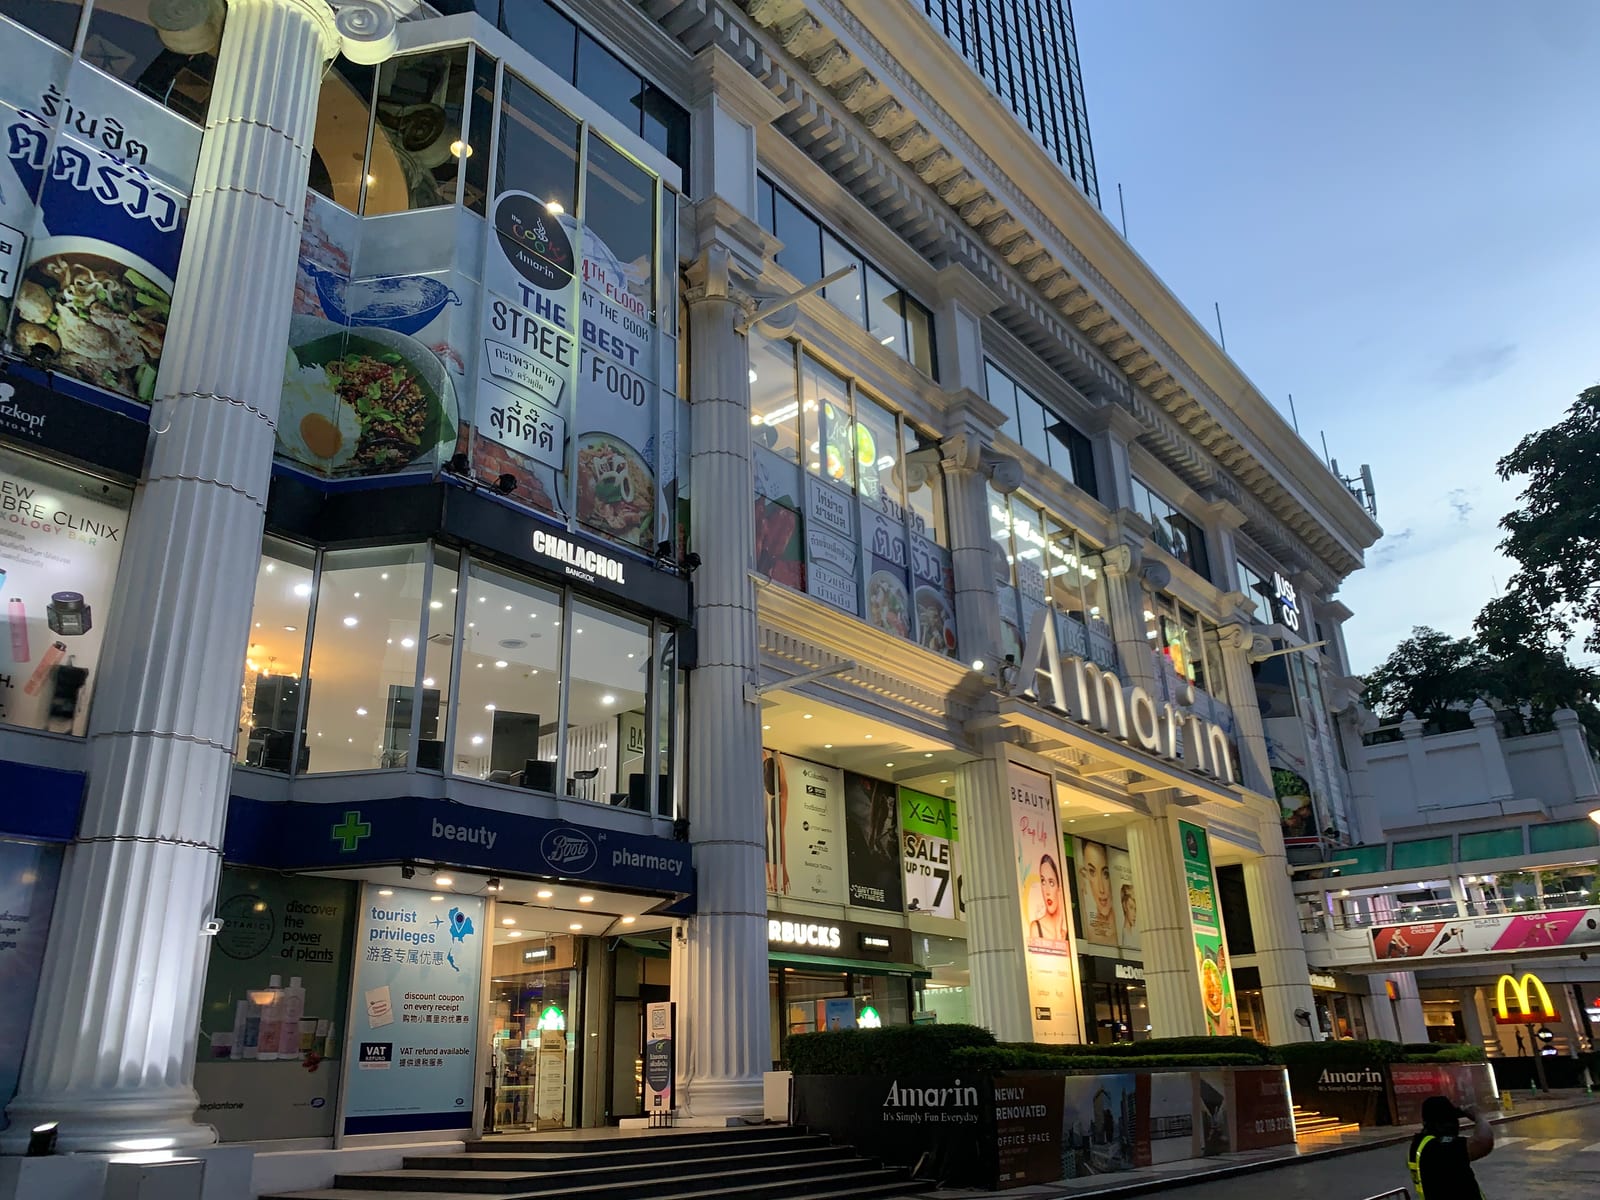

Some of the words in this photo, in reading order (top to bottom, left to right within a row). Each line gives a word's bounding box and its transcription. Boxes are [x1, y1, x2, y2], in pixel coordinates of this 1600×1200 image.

[511, 213, 522, 225] the
[515, 250, 555, 280] Amarin
[606, 283, 645, 317] FLOOR
[518, 281, 567, 329] THE
[582, 318, 640, 367] BEST
[582, 290, 594, 309] AT
[600, 301, 618, 324] THE
[623, 316, 649, 342] COOK
[504, 366, 514, 378] by
[592, 356, 646, 407] FOOD
[53, 511, 120, 542] CLINIX
[68, 530, 97, 546] BAR
[533, 530, 625, 584] CHALACHOL
[565, 566, 595, 583] BANGKOK
[1020, 607, 1234, 785] Amarin
[1011, 786, 1051, 812] BEAUTY
[431, 818, 497, 849] beauty
[548, 835, 589, 863] Boots
[906, 835, 949, 865] SALE
[612, 848, 684, 875] pharmacy
[905, 862, 917, 874] UP
[919, 864, 931, 877] TO
[286, 901, 337, 917] discover
[371, 907, 417, 923] tourist
[284, 915, 304, 929] the
[282, 931, 322, 944] power
[369, 927, 435, 945] privileges
[281, 946, 295, 959] of
[296, 947, 334, 962] plants
[366, 946, 444, 966] 游客专属优惠
[404, 991, 436, 1001] discount
[438, 993, 464, 1003] coupon
[415, 1004, 433, 1012] every
[434, 1003, 459, 1012] receipt
[366, 1046, 387, 1056] VAT
[399, 1047, 413, 1055] VAT
[415, 1047, 438, 1055] refund
[439, 1047, 470, 1056] available
[1318, 1067, 1382, 1084] Amarin
[883, 1078, 978, 1107] Amarin
[994, 1087, 1025, 1101] NEWLY
[883, 1112, 894, 1121] It's
[895, 1112, 922, 1124] Simply
[924, 1112, 939, 1121] Fun
[941, 1112, 978, 1124] Everyday
[995, 1104, 1047, 1120] RENOVATED
[997, 1134, 1025, 1147] OFFICE
[1028, 1131, 1051, 1144] SPACE
